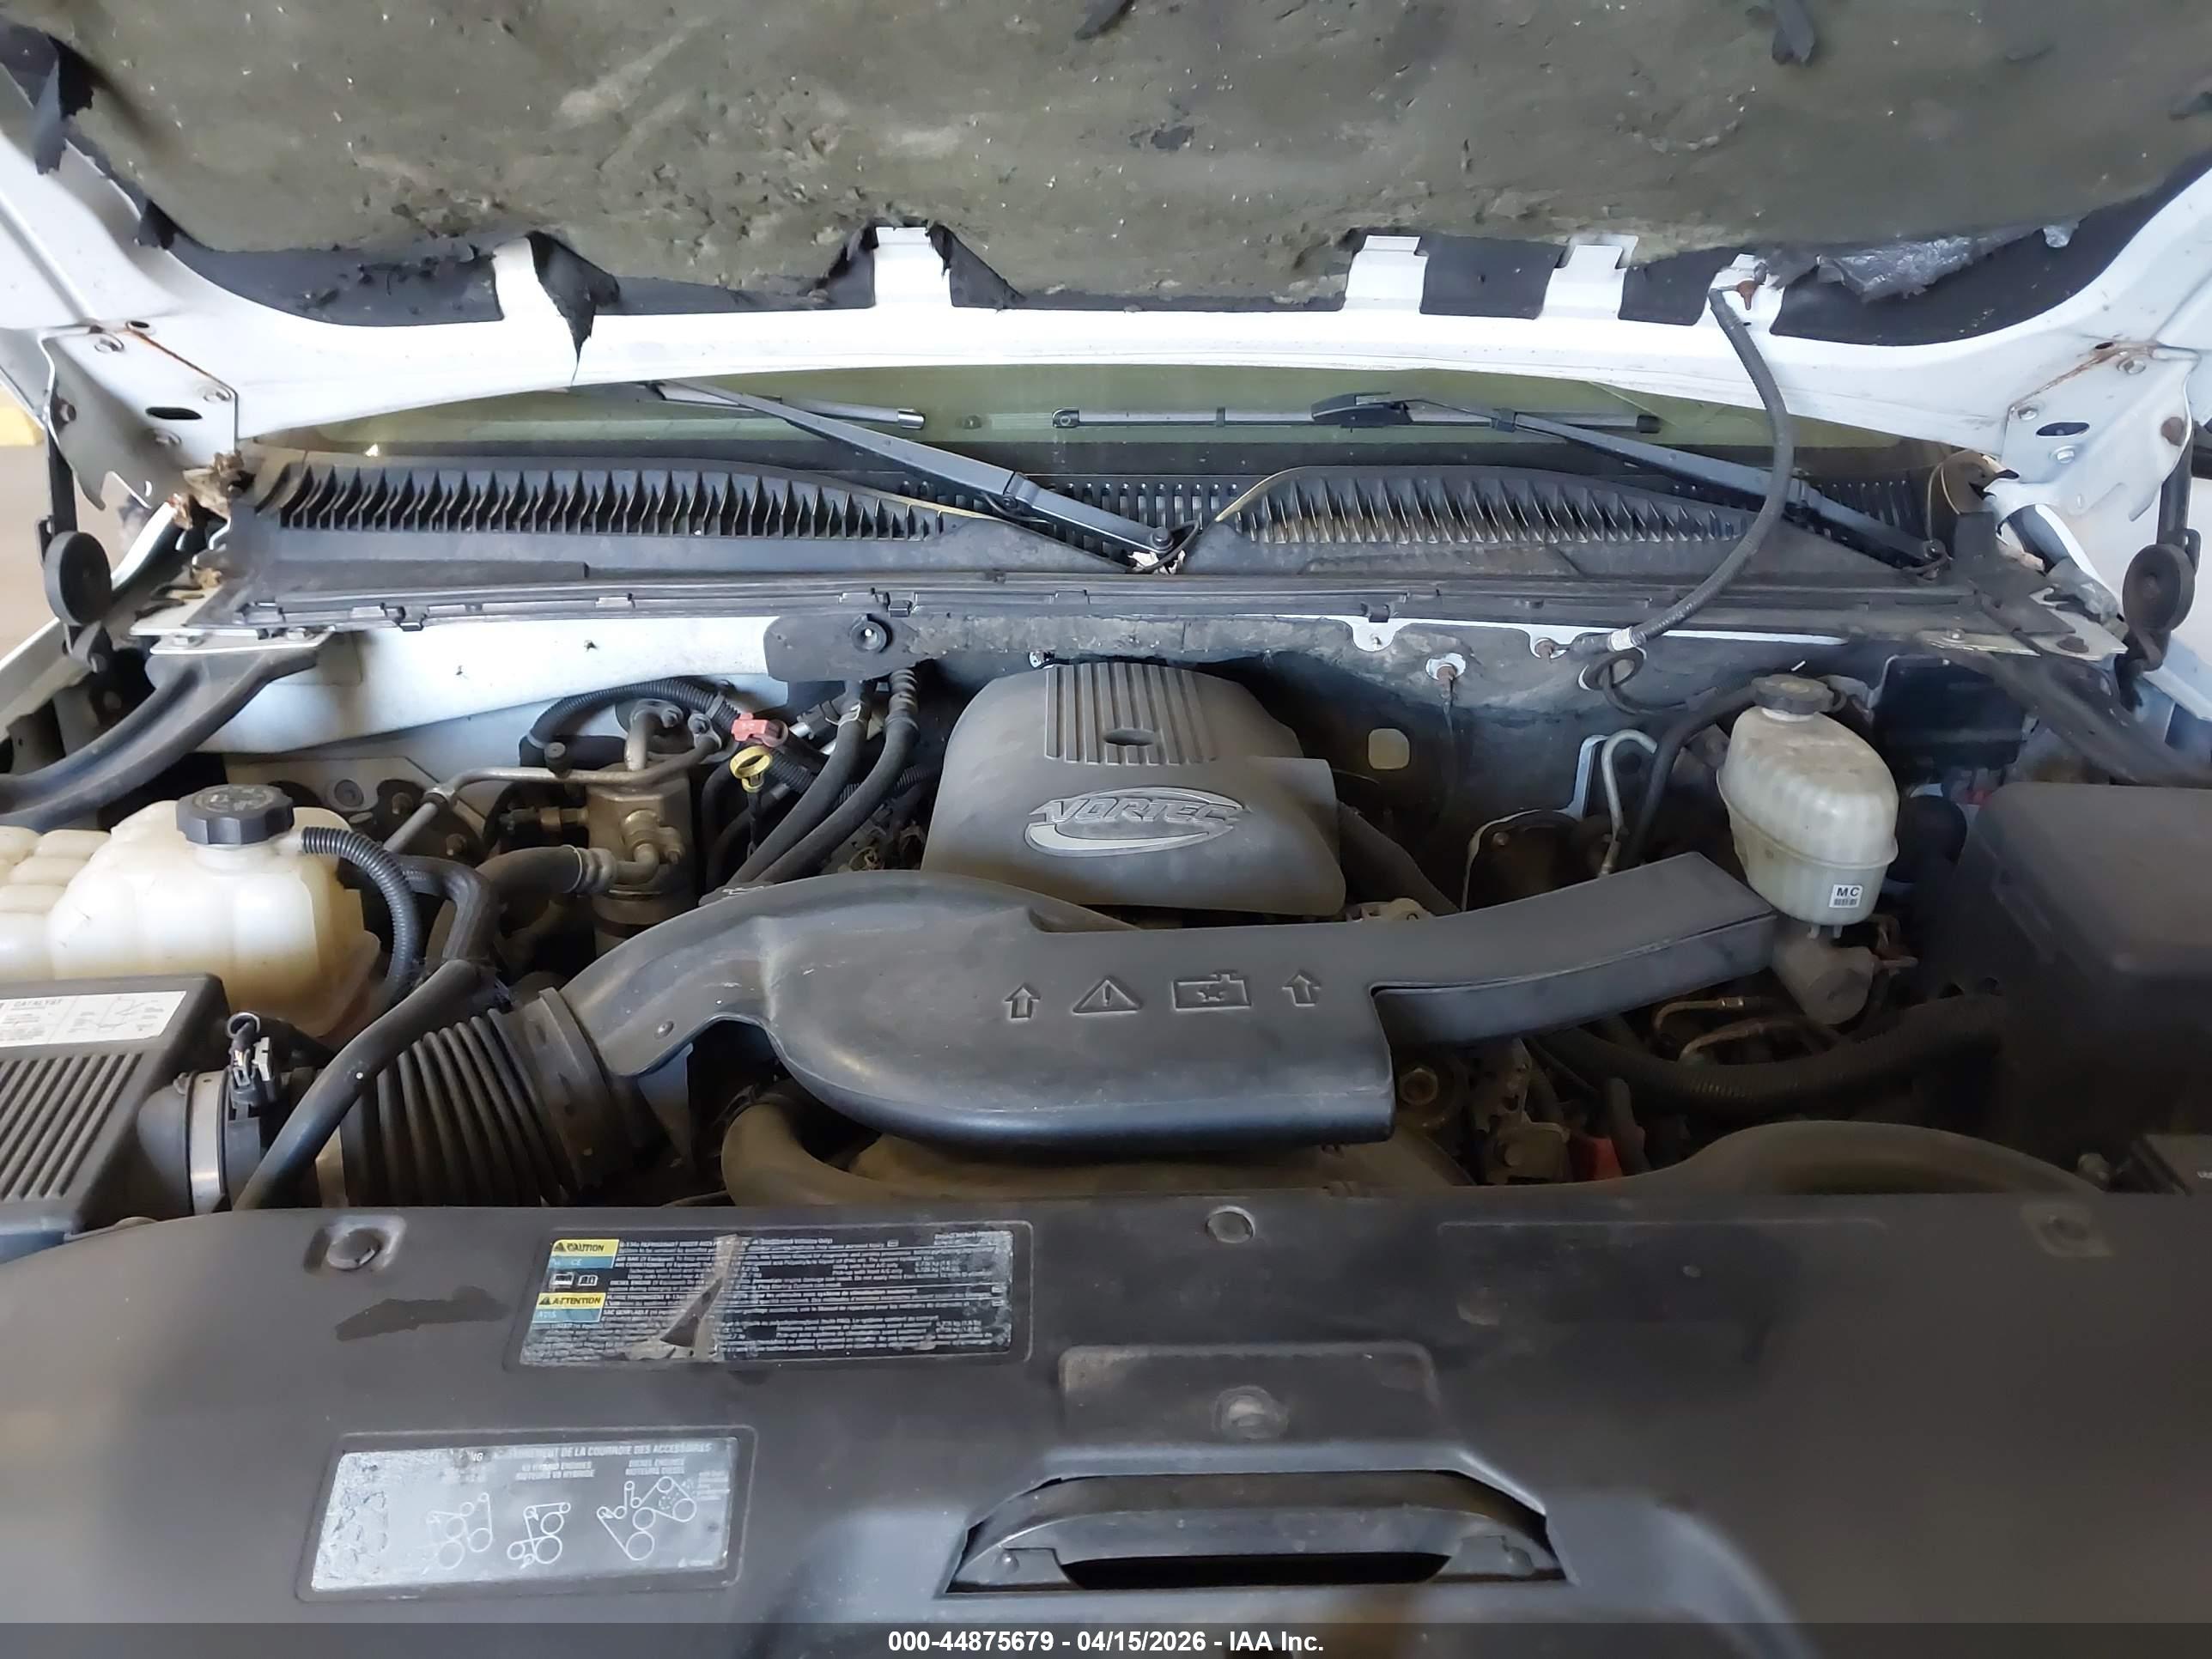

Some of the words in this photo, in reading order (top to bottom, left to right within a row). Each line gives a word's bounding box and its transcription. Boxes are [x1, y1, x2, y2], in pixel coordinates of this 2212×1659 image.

[1035, 798, 1237, 824] VORTEC
[1836, 887, 1860, 897] MC
[567, 1243, 605, 1253] CAUTION
[551, 1297, 601, 1305] ATTENTION
[574, 1445, 587, 1457] LA
